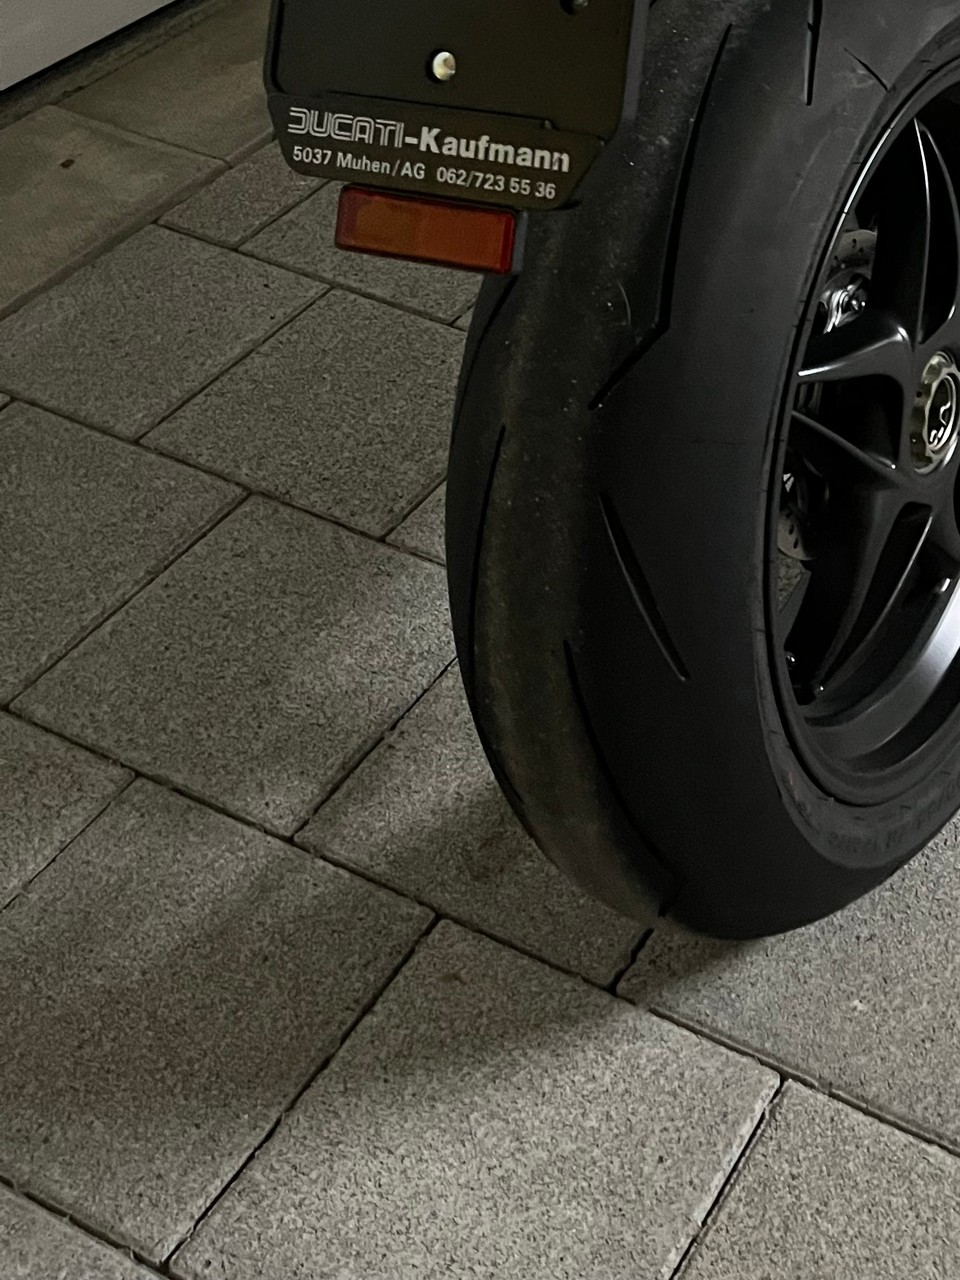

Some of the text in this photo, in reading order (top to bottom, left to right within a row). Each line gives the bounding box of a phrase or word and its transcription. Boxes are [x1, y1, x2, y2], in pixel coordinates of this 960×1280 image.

[293, 146, 332, 165] 5037
[436, 166, 505, 191] 062/723
[509, 177, 531, 195] 55
[534, 181, 557, 199] 36
